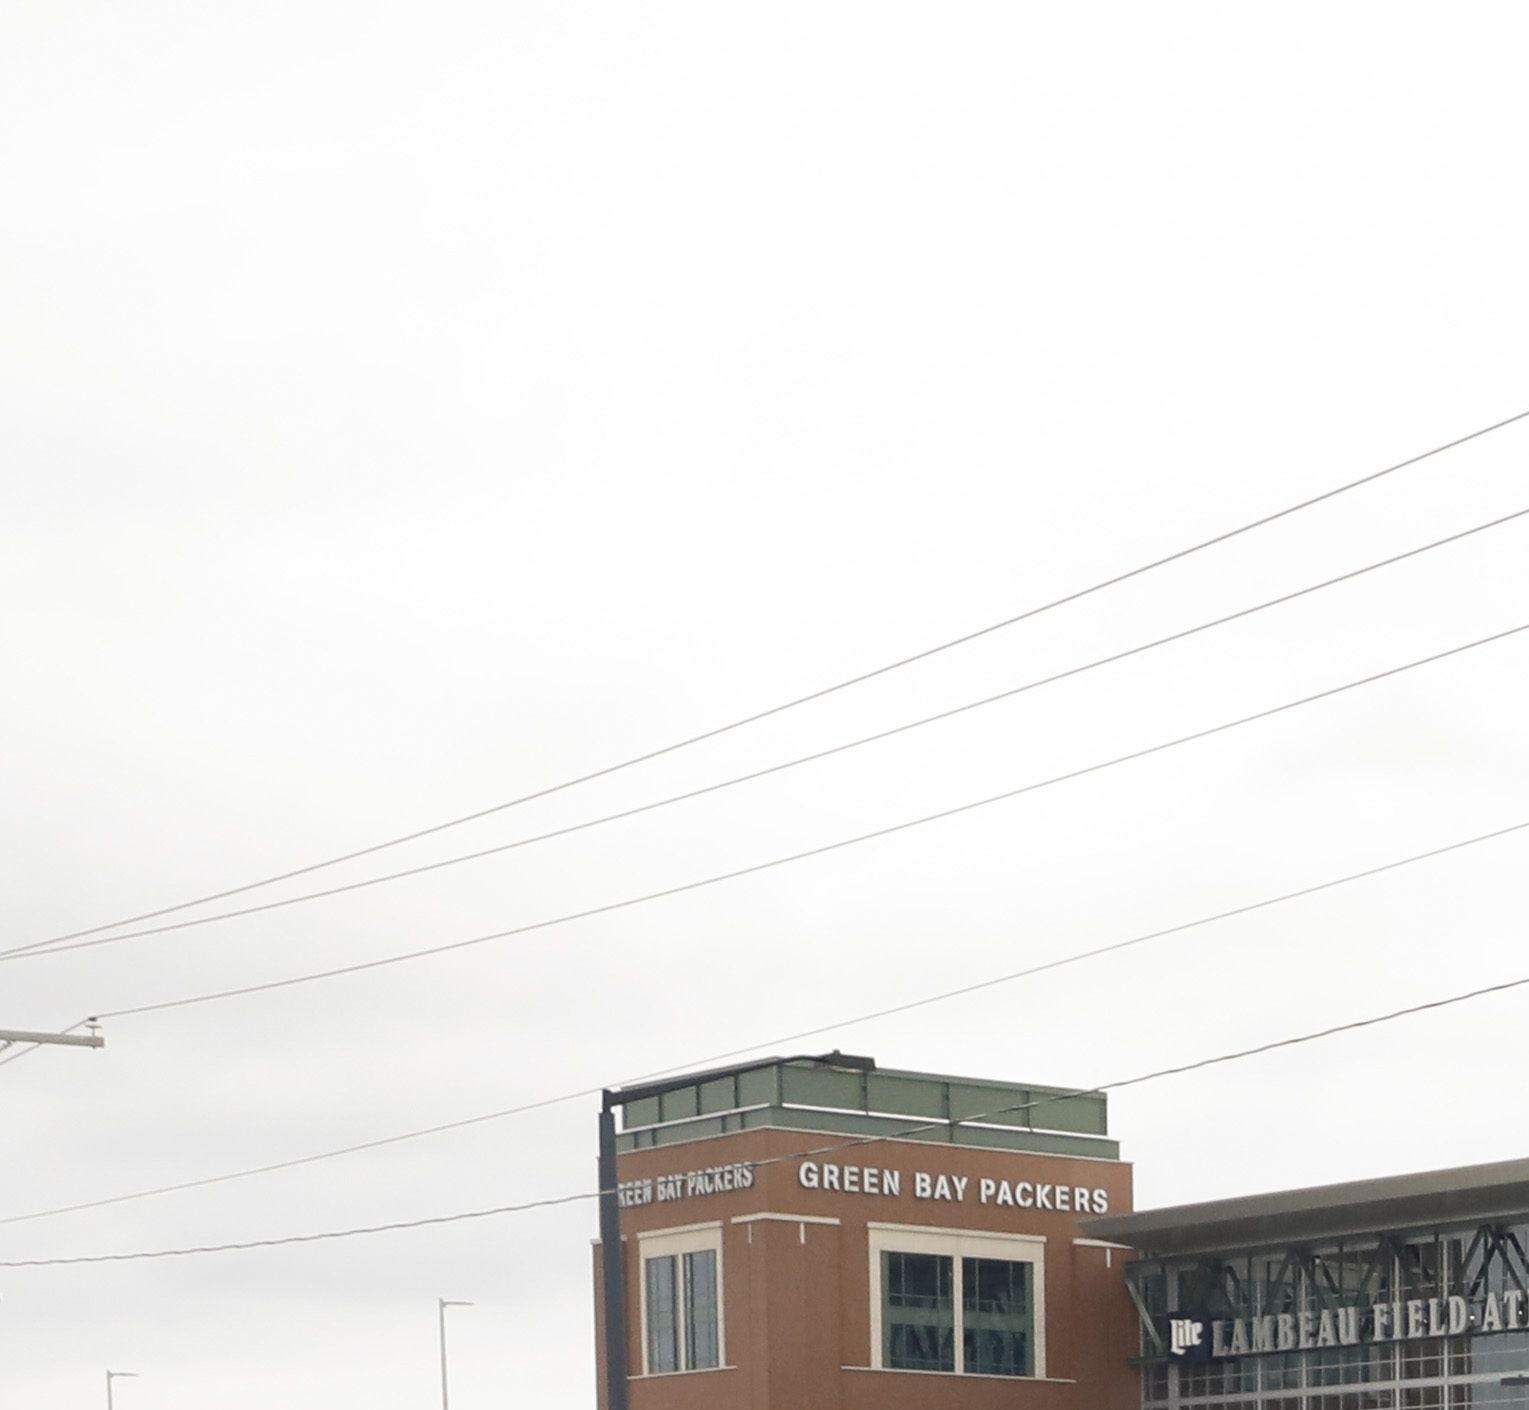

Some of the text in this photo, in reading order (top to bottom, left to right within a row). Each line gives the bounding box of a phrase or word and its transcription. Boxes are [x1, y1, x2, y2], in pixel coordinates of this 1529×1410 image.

[618, 1180, 652, 1207] REEN
[687, 1161, 753, 1196] PACKERS
[799, 1161, 1109, 1214] GREEN BAY PACKERS
[1170, 1318, 1203, 1356] Lite
[1212, 1307, 1360, 1357] LAMBEAU
[1373, 1296, 1468, 1342] FIELD
